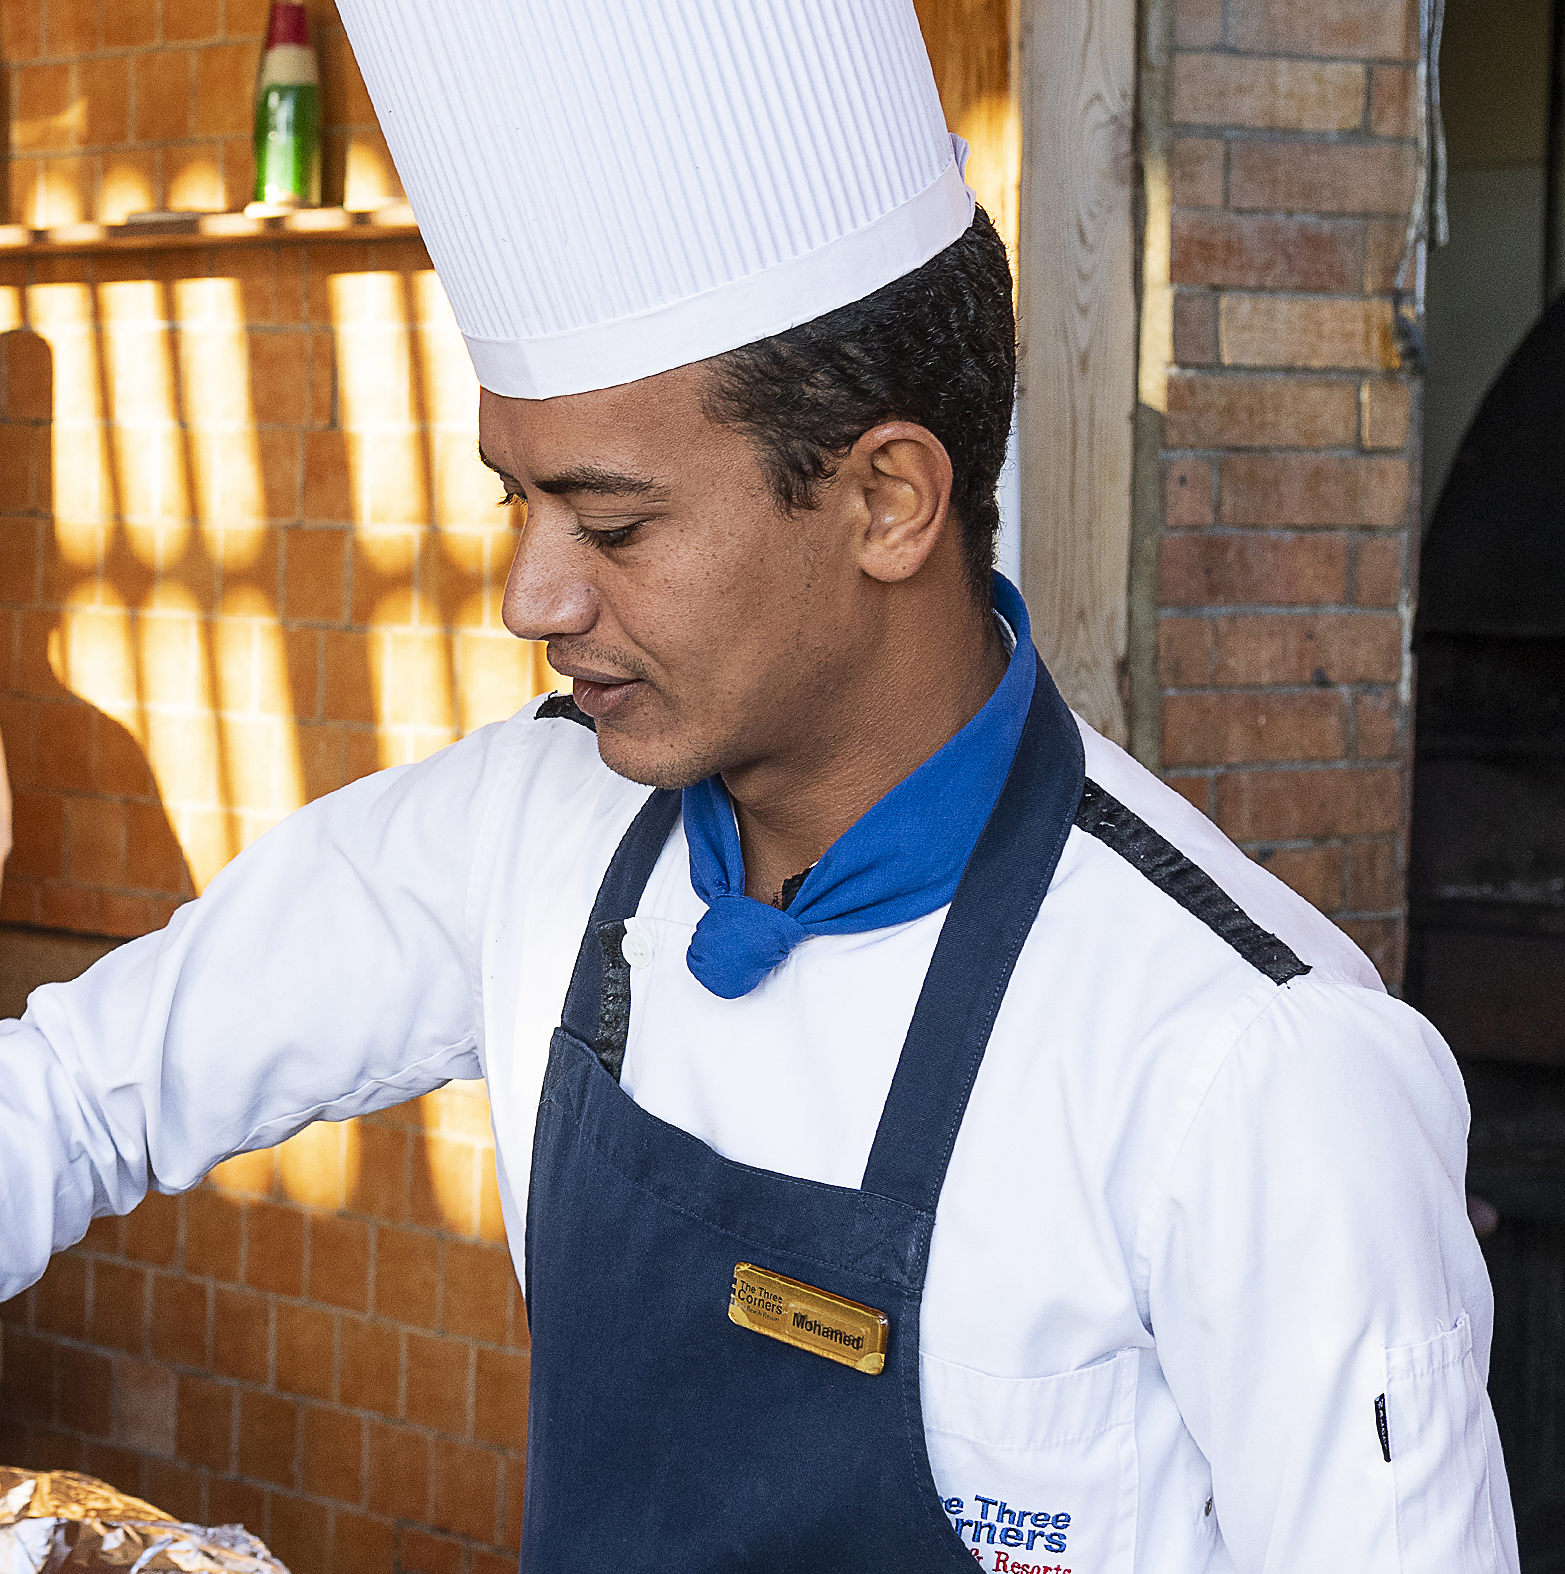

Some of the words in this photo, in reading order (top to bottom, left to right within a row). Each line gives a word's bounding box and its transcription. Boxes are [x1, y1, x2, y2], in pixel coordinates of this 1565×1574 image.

[738, 1289, 782, 1315] Corners
[740, 1280, 756, 1294] The
[759, 1286, 783, 1304] Three
[974, 1494, 1072, 1530] Three
[954, 1517, 1068, 1554] rners
